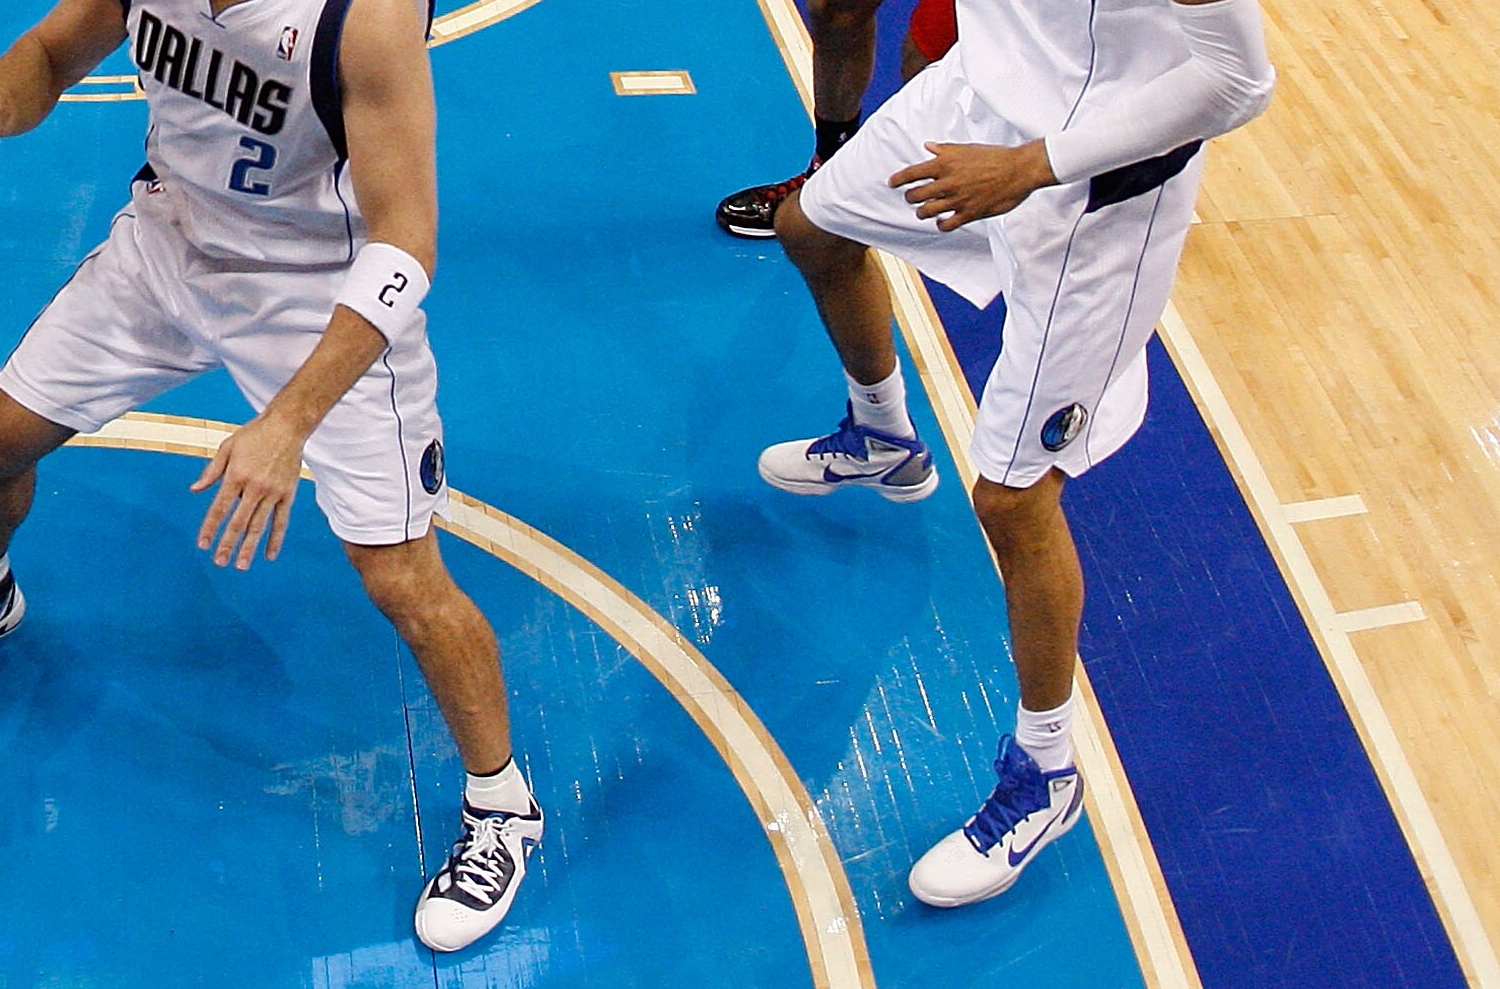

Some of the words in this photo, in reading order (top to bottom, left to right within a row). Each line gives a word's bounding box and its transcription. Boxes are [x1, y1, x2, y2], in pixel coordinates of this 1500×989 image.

[135, 9, 294, 136] DALLAS
[228, 136, 279, 197] 2
[377, 271, 408, 308] 2
